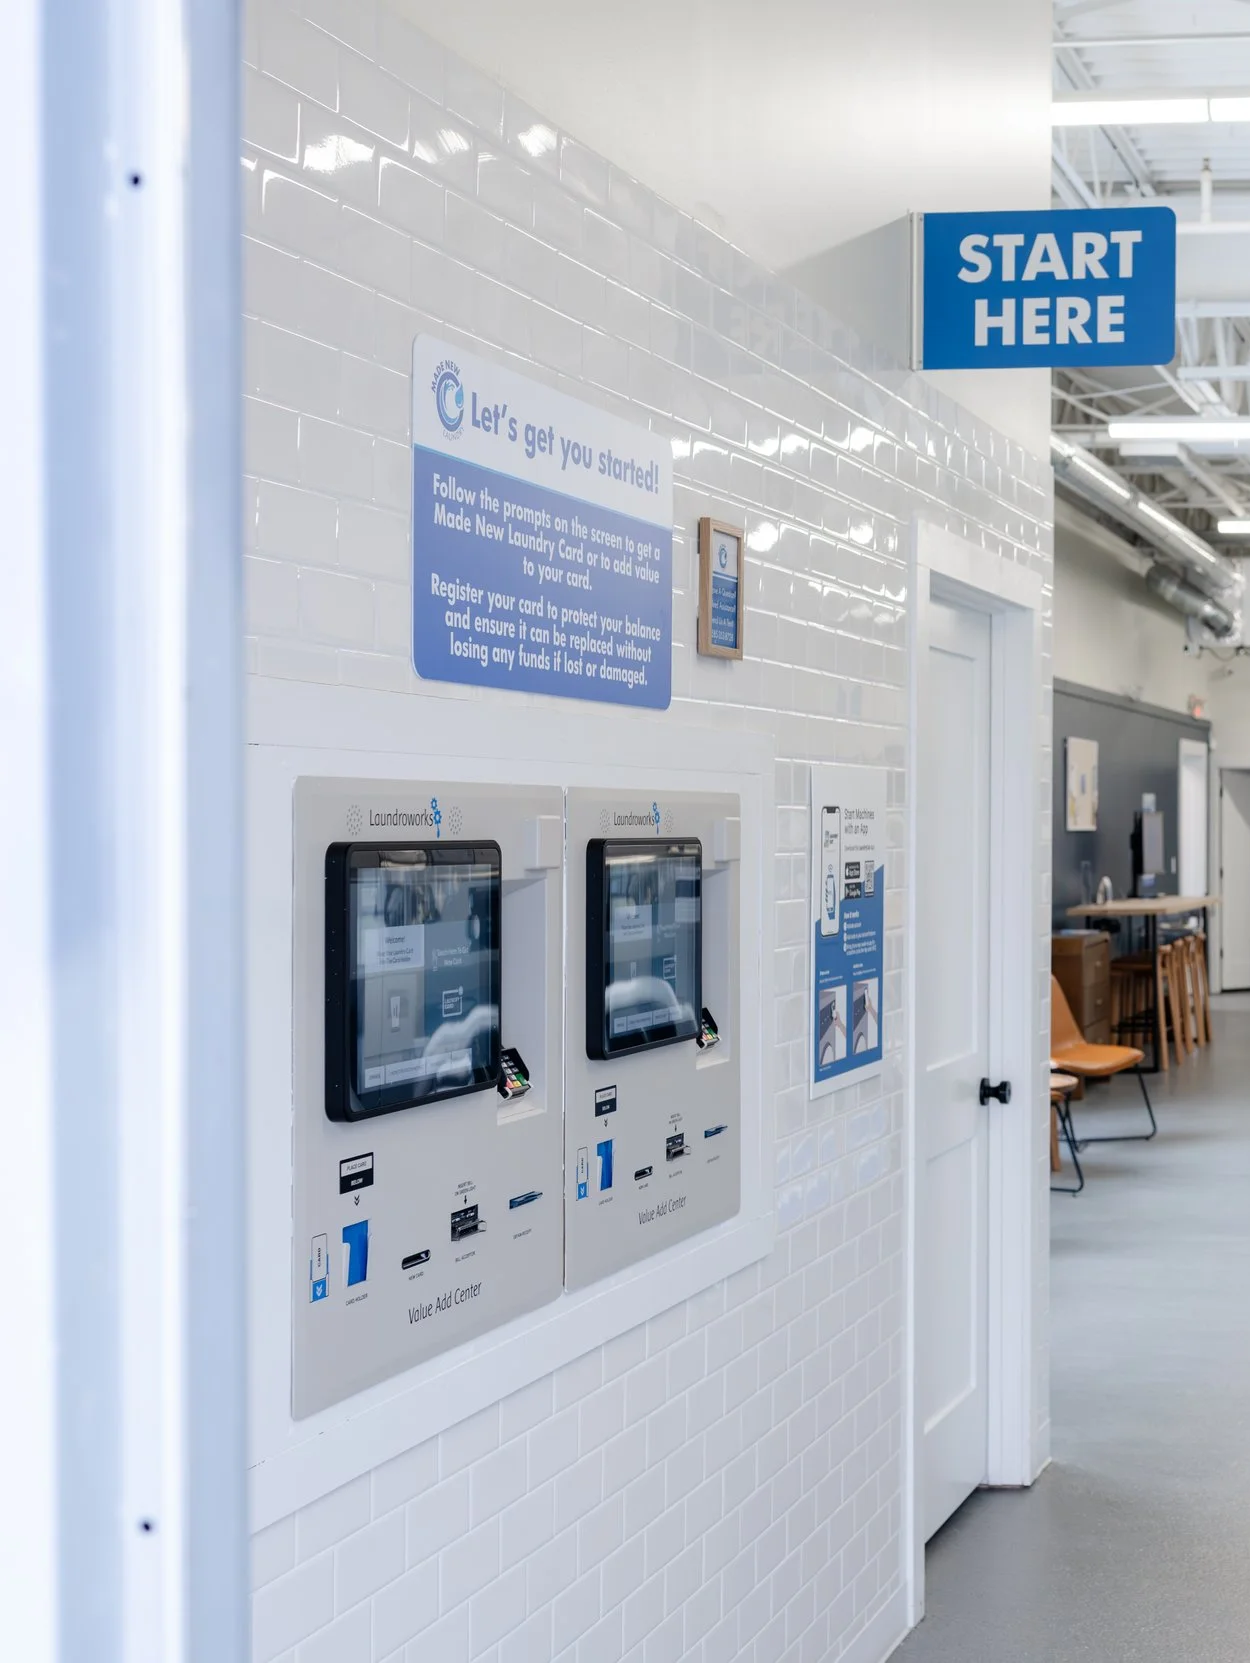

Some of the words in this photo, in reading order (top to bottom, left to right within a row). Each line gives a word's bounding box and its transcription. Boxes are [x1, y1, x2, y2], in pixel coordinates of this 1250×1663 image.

[957, 230, 1142, 283] START
[974, 295, 1125, 347] HERE
[431, 361, 445, 393] MADE
[445, 360, 461, 376] NEW
[471, 391, 518, 442] Let's
[524, 423, 555, 459] get
[560, 436, 592, 471] you
[598, 448, 659, 494] started!
[433, 472, 476, 506] Follow
[480, 487, 499, 513] the
[503, 501, 551, 532] prompts
[554, 517, 568, 534] on
[571, 515, 588, 539] the
[591, 527, 622, 550] screen
[625, 535, 635, 554] to
[637, 541, 652, 561] get
[654, 548, 661, 561] a
[433, 502, 472, 533] Made
[475, 513, 504, 542] New
[508, 523, 555, 562] Laundry
[558, 538, 584, 564] Card
[586, 552, 598, 567] or
[600, 552, 611, 571] to
[613, 554, 632, 577] add
[635, 562, 660, 584] value
[523, 556, 535, 577] to
[538, 563, 564, 585] your
[566, 569, 593, 591] card.
[431, 572, 484, 606] Register
[487, 591, 516, 613] your
[518, 595, 544, 617] card
[547, 601, 558, 620] to
[561, 607, 598, 628] protect
[600, 615, 622, 636] your
[625, 614, 661, 641] balance
[445, 606, 470, 630] and
[474, 616, 516, 638] ensure
[519, 618, 527, 640] it
[530, 627, 550, 644] can
[553, 624, 567, 647] be
[569, 630, 613, 657] replaced
[616, 639, 652, 663] without
[450, 631, 488, 667] losing
[492, 647, 515, 671] any
[518, 644, 550, 671] funds
[553, 650, 561, 672] if
[564, 651, 583, 675] lost
[586, 662, 597, 677] or
[600, 658, 648, 689] damaged.
[369, 808, 434, 827] Laundroworks
[613, 811, 655, 827] Laundroworks
[844, 808, 855, 820] Start
[855, 808, 875, 820] Machines
[844, 823, 853, 834] with
[854, 826, 860, 834] an
[860, 823, 868, 836] App
[358, 1160, 367, 1168] CARD
[638, 1208, 655, 1225] Value
[656, 1200, 668, 1218] Add
[668, 1195, 687, 1213] Center
[408, 1303, 433, 1324] Value
[435, 1291, 452, 1314] Add
[454, 1282, 482, 1305] Center
